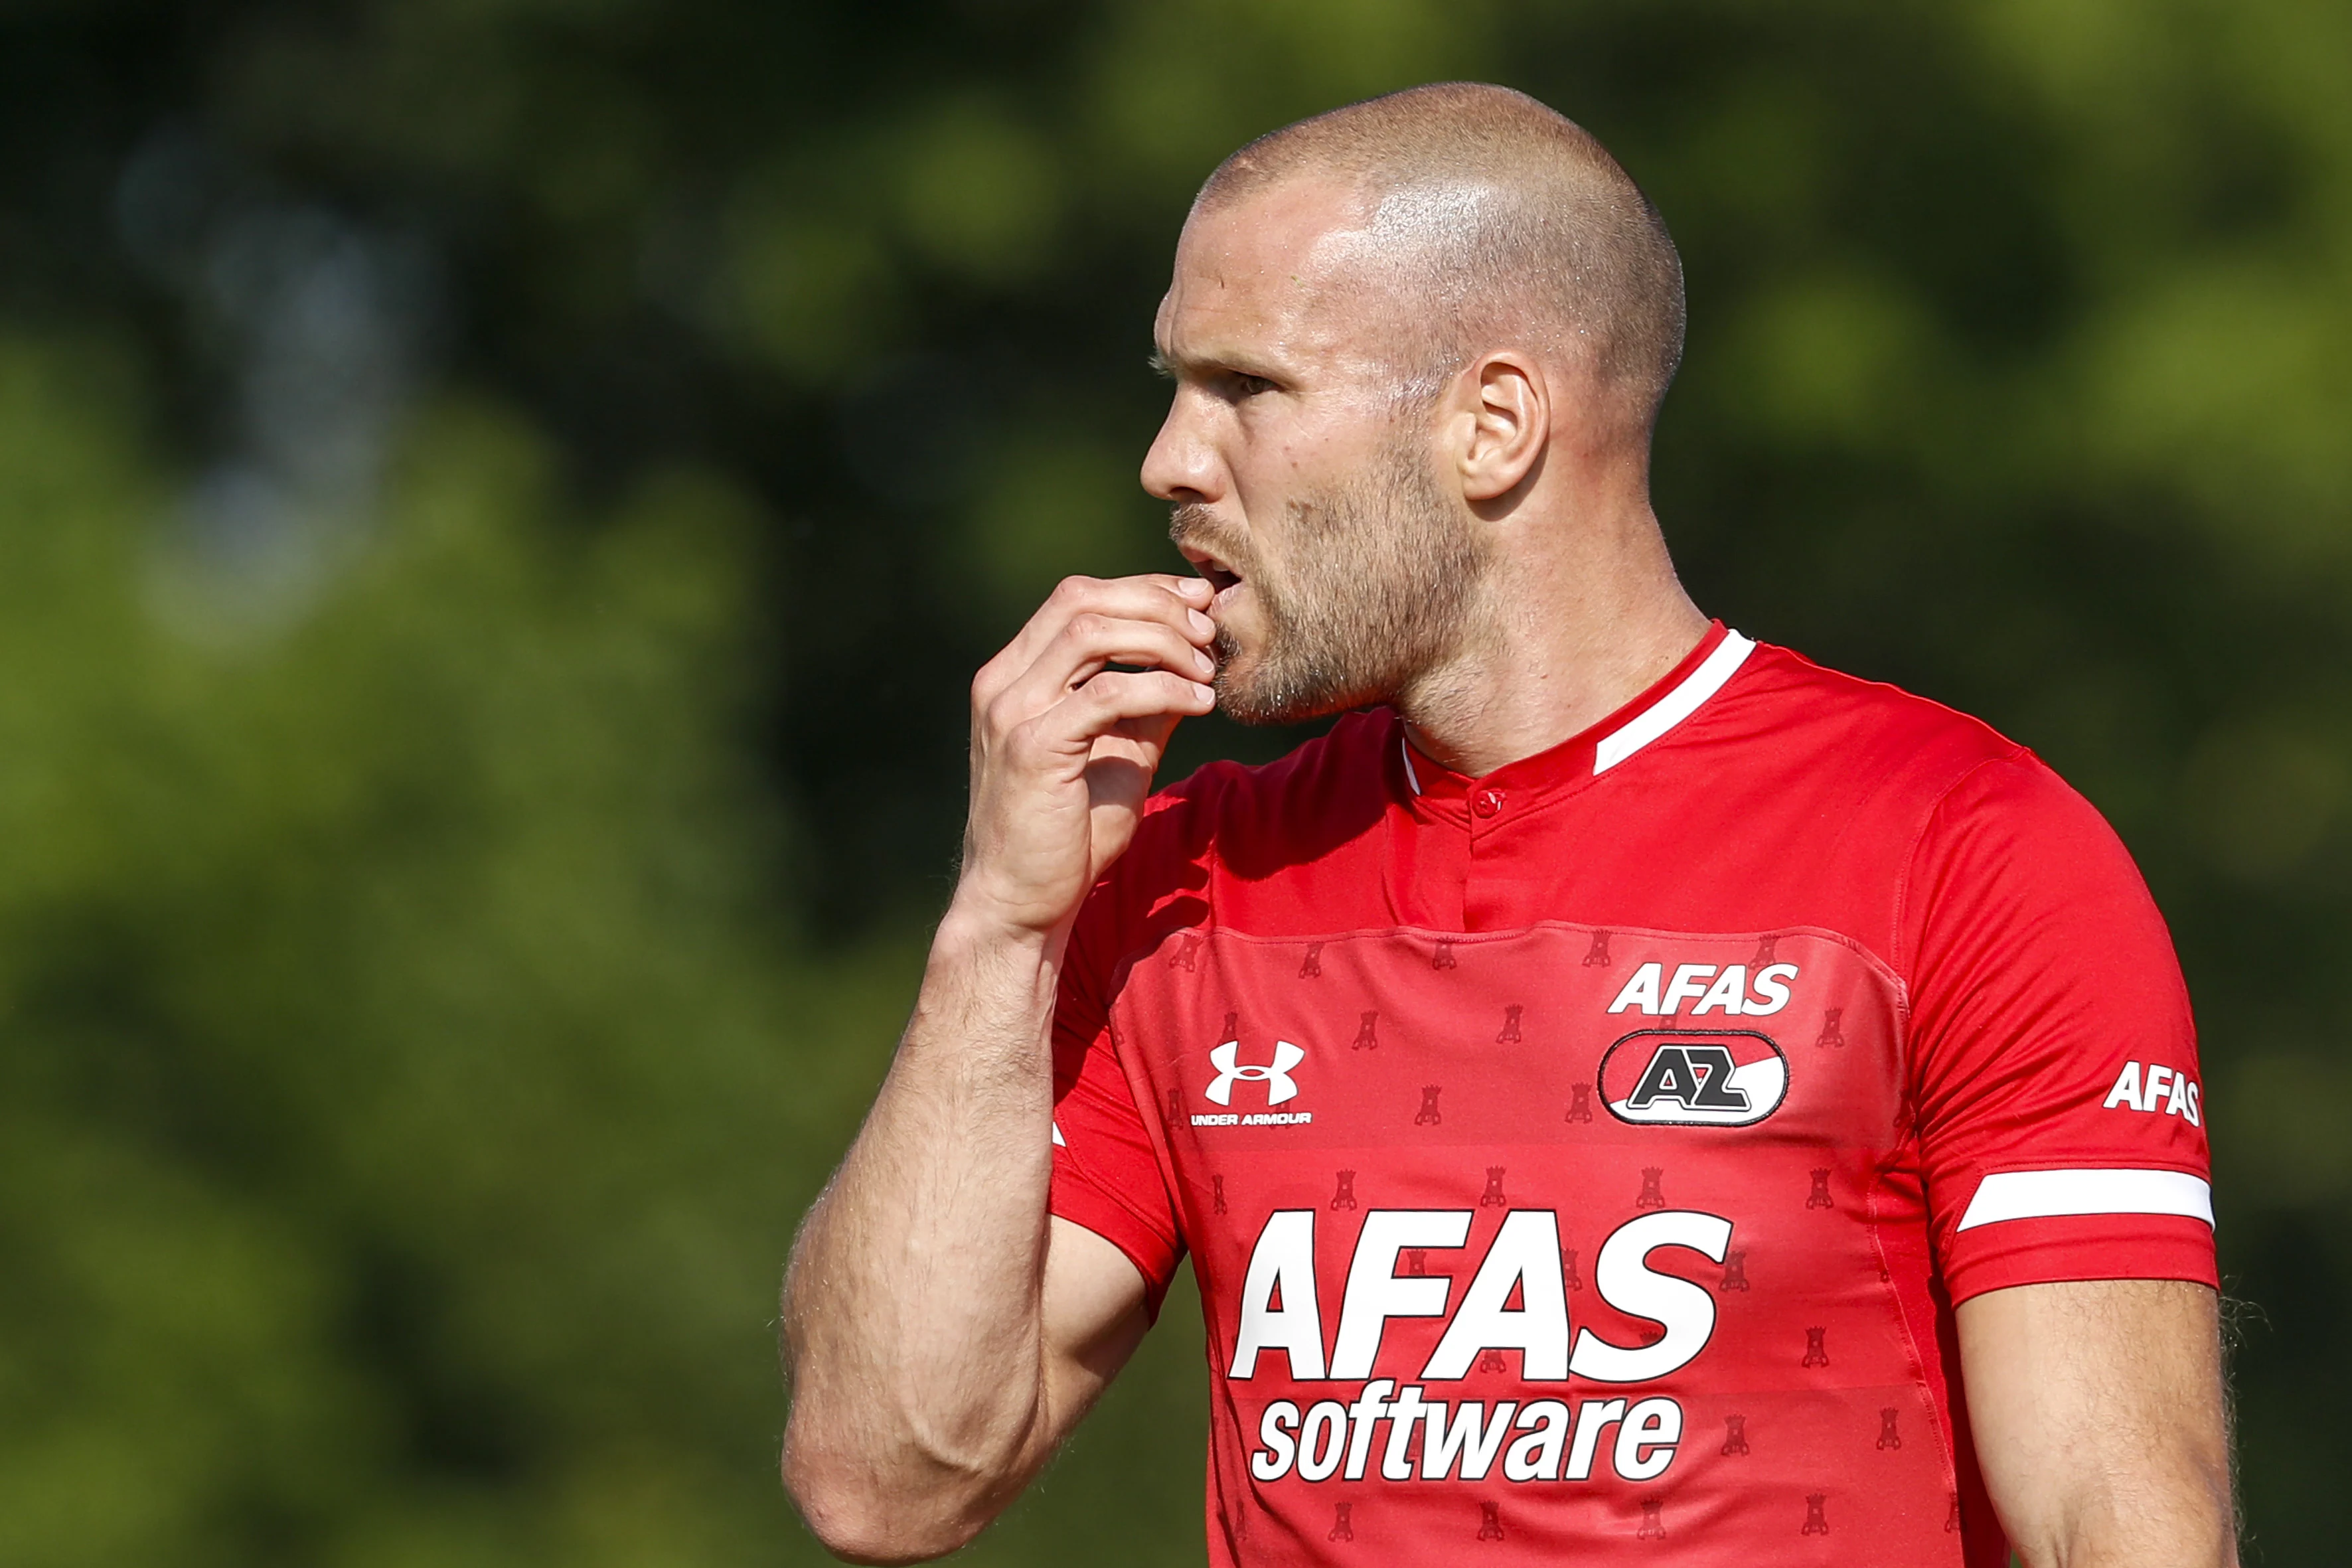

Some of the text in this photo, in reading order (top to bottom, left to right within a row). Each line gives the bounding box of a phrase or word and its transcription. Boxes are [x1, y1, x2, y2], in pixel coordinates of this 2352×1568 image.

[1607, 962, 1800, 1016] AFAS
[1626, 1044, 1752, 1112] AZ
[2102, 1060, 2200, 1127] AFAS
[1191, 1112, 1312, 1127] UNDER ARMOUR
[1228, 1210, 1734, 1383] AFAS
[1250, 1379, 1684, 1482] software
